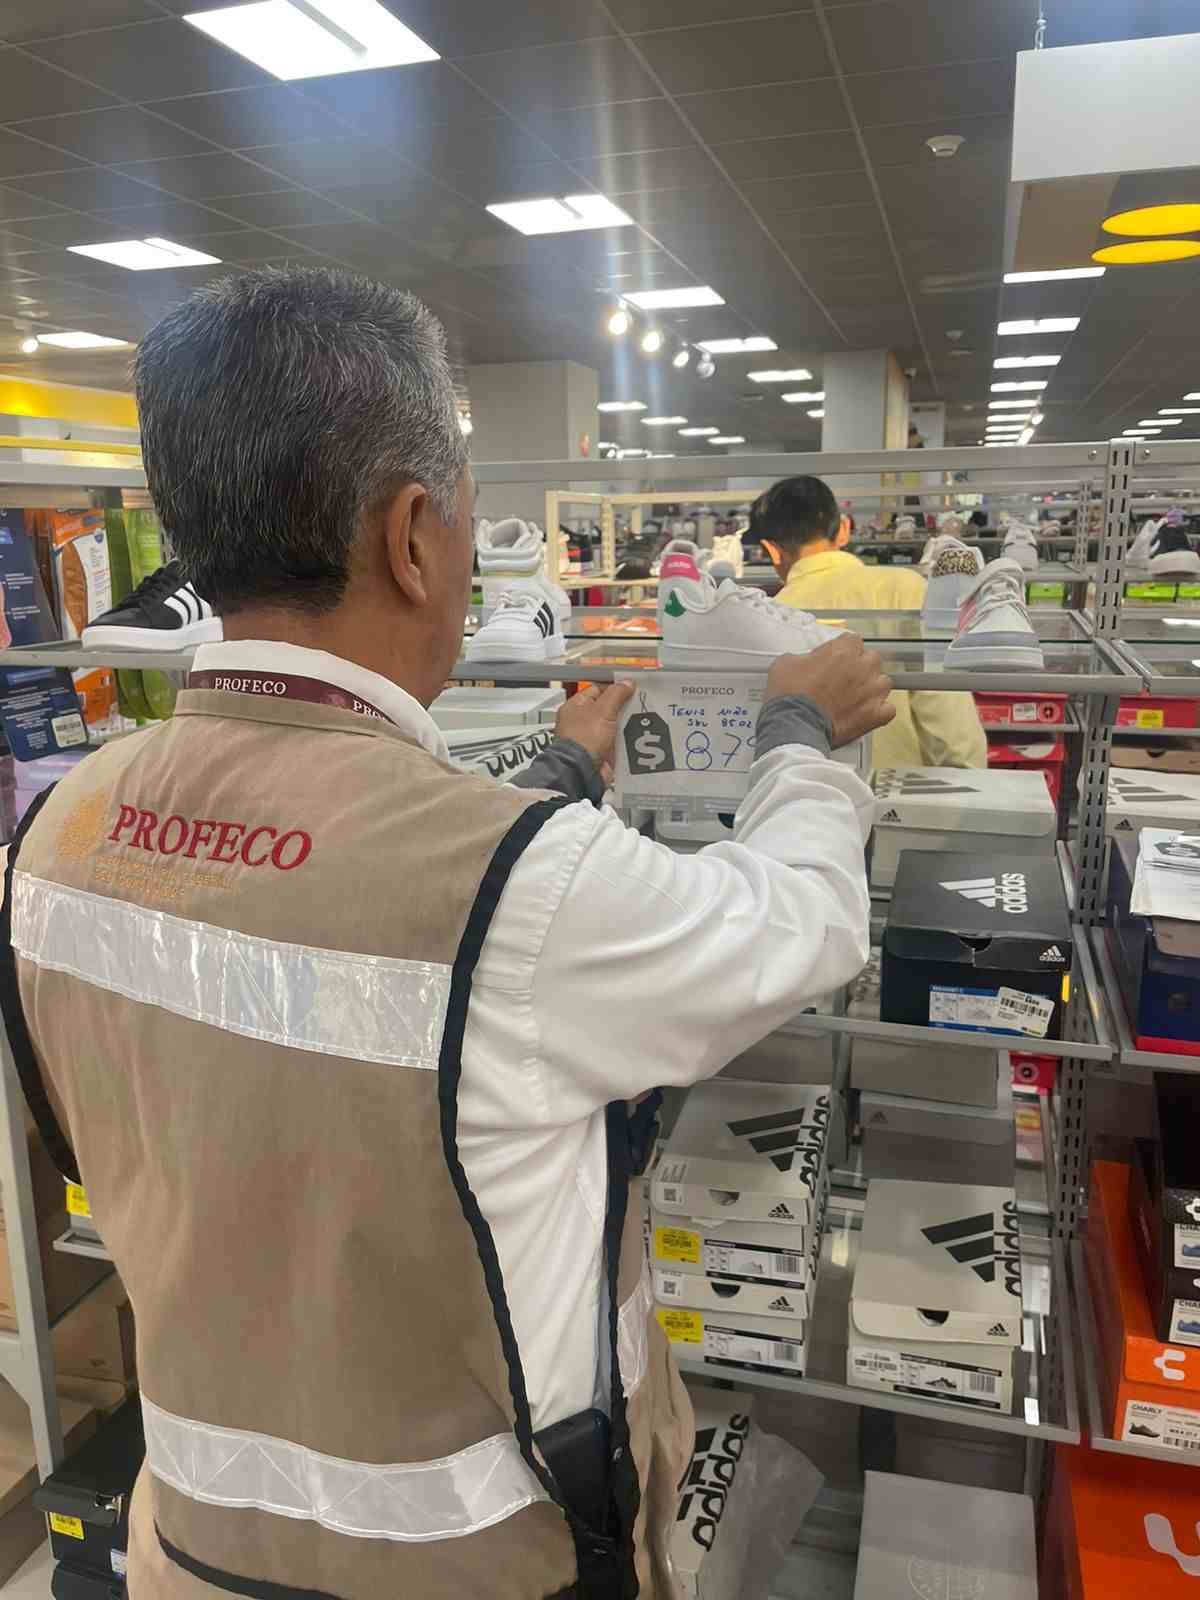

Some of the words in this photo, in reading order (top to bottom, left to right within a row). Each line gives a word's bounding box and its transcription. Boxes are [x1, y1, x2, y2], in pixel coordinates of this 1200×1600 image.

[215, 677, 287, 695] PROFECO
[681, 686, 735, 695] PROFECO
[108, 804, 312, 870] PROFECO
[995, 873, 1028, 913] adidas
[692, 1413, 750, 1553] adidas
